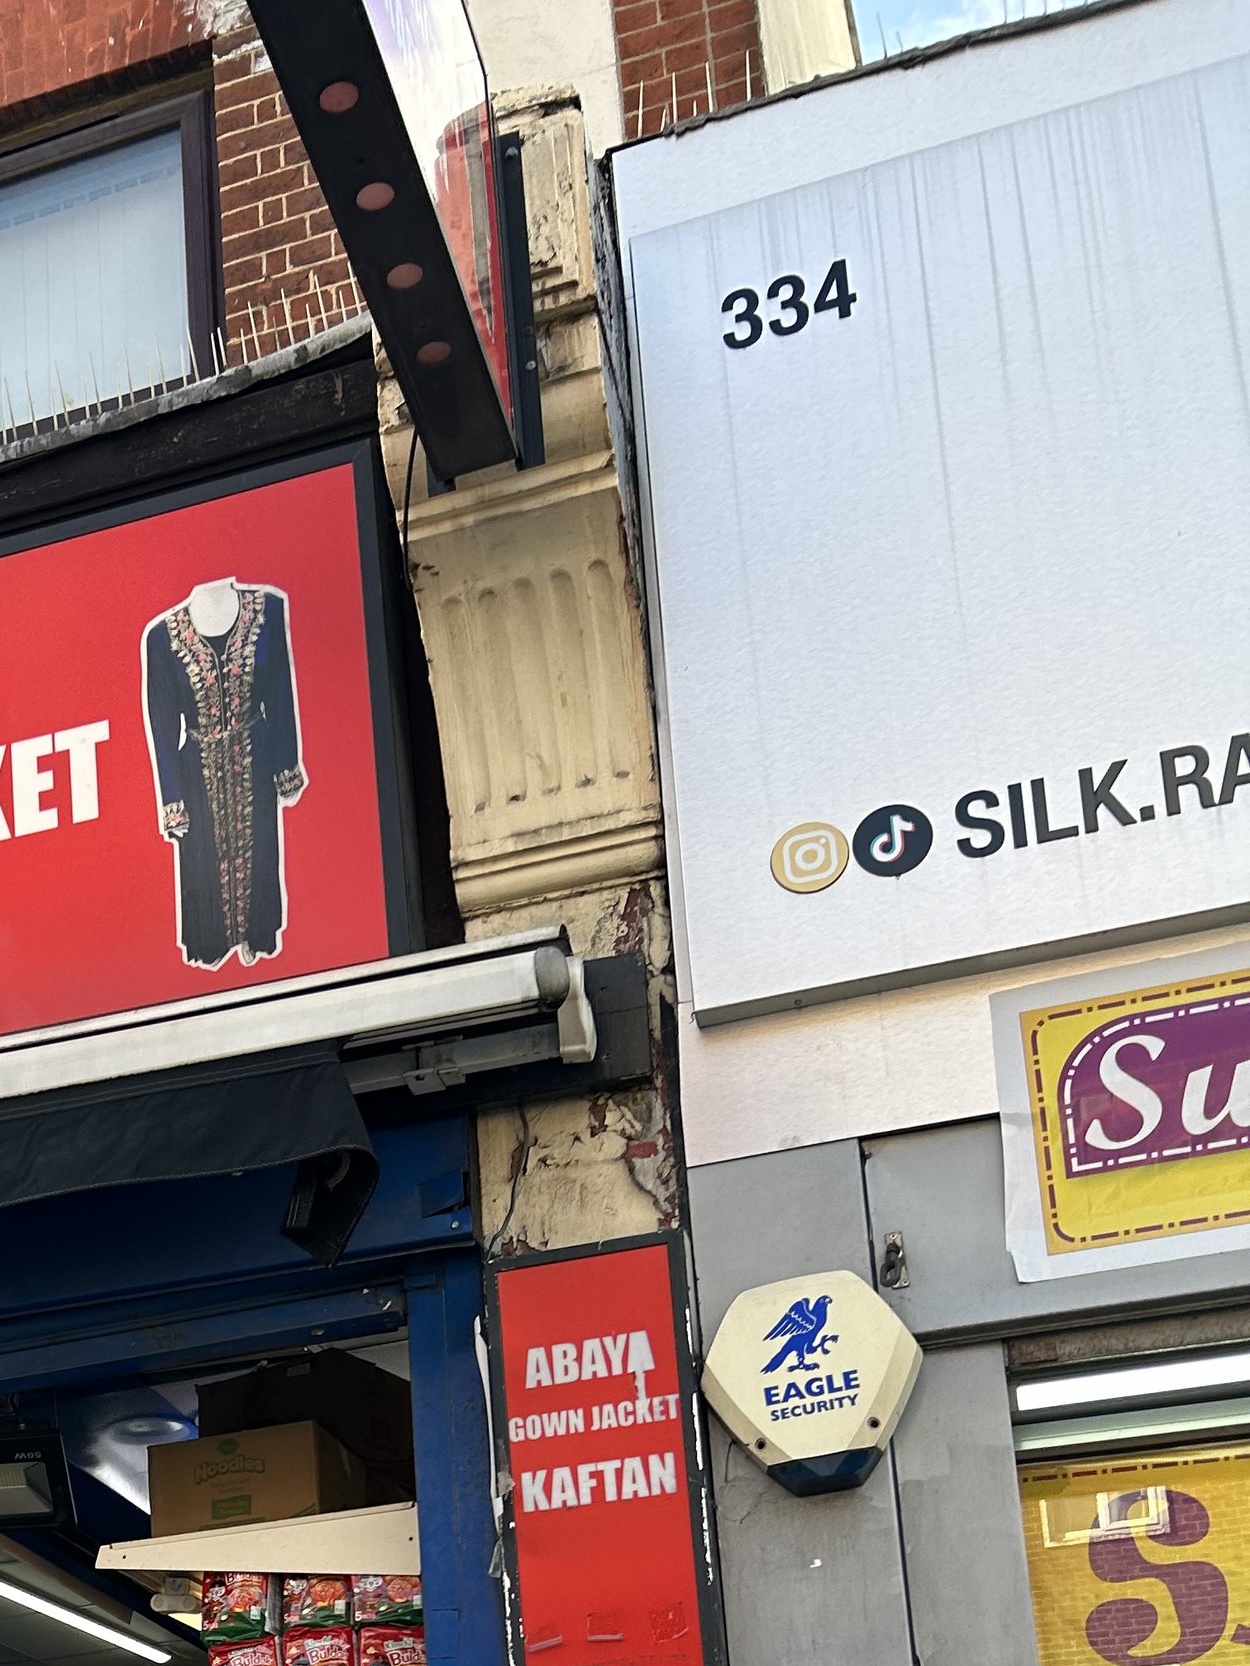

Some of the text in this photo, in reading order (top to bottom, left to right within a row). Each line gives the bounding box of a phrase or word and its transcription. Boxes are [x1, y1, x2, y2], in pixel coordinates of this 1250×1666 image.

[721, 258, 856, 349] 334
[524, 1330, 655, 1390] ABAYA
[763, 1370, 860, 1406] EAGLE
[770, 1394, 858, 1422] SECURITY
[508, 1393, 679, 1442] GOWN JACKET
[519, 1451, 677, 1513] KAFTAN
